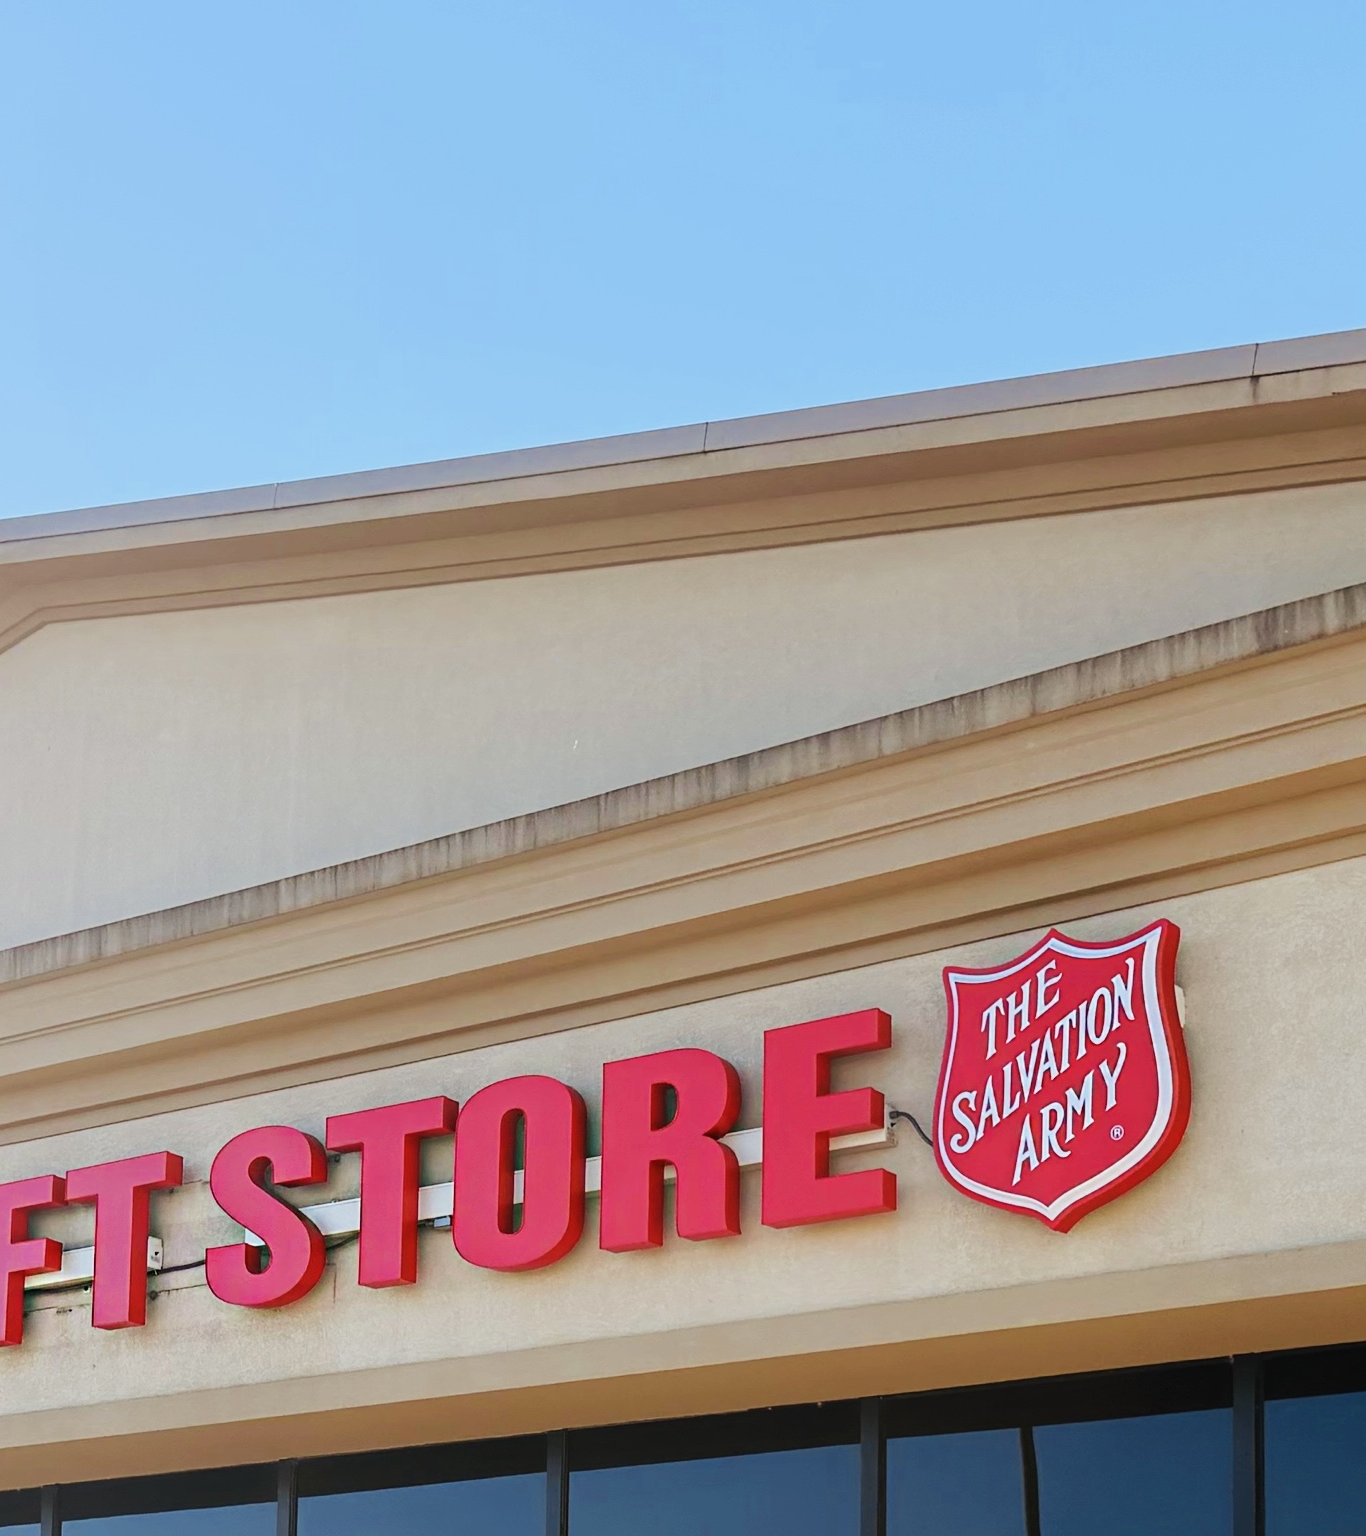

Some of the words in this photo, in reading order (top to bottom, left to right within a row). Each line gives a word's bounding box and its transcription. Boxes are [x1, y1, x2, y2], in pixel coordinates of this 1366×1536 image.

[949, 957, 1136, 1154] SALVATION
[981, 959, 1063, 1061] THE
[205, 1007, 898, 1309] STORE
[1011, 1042, 1127, 1187] ARMY
